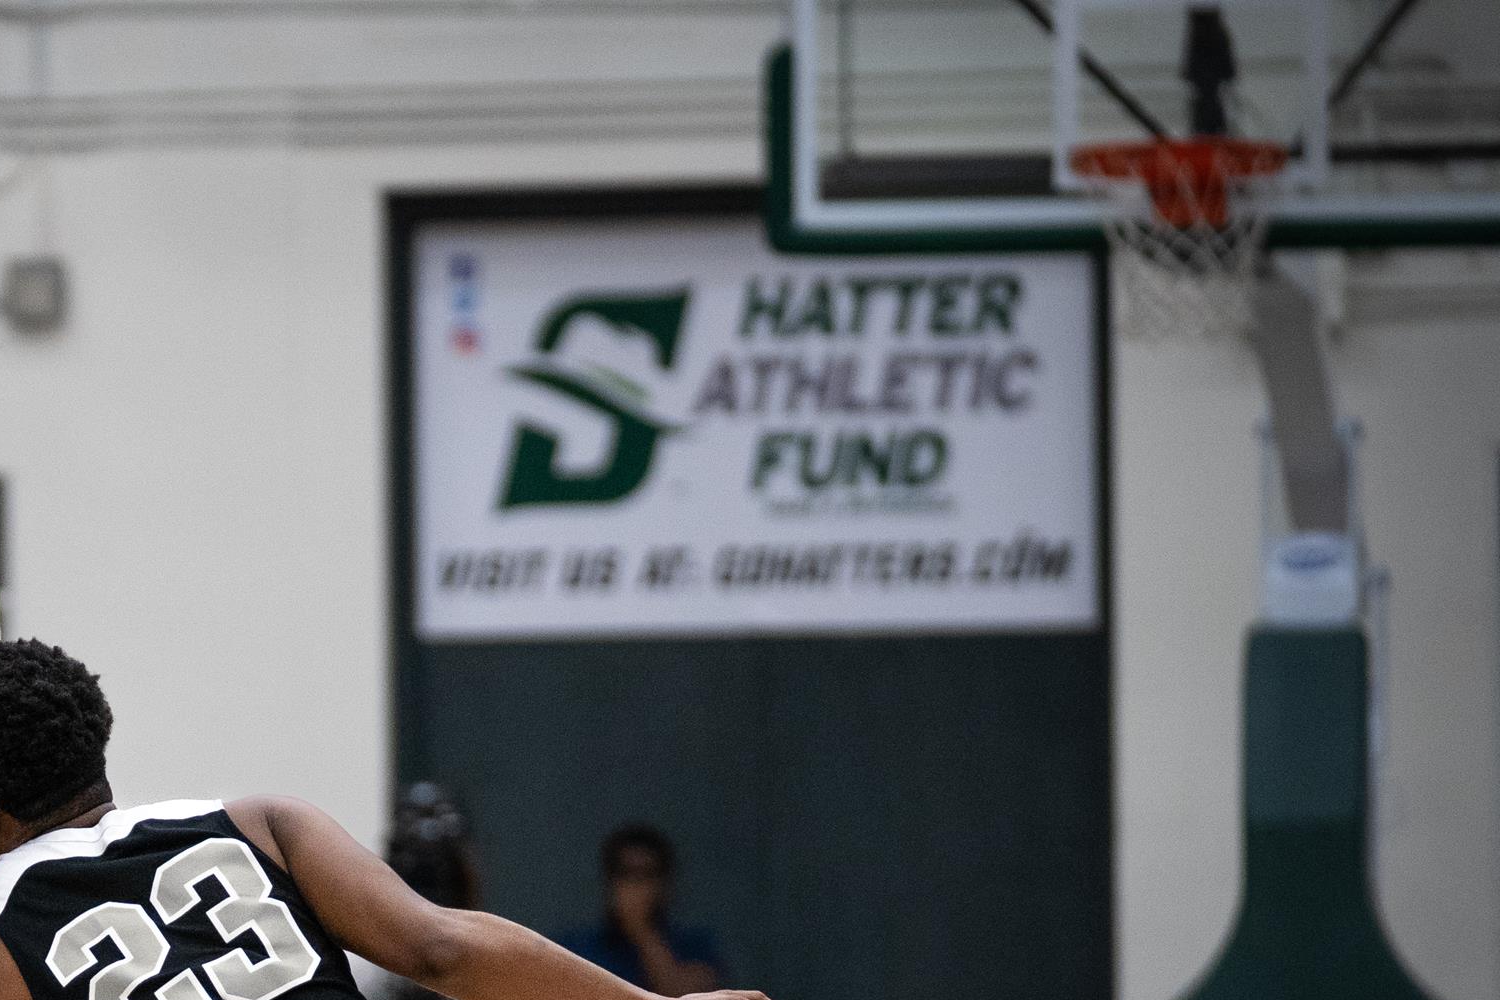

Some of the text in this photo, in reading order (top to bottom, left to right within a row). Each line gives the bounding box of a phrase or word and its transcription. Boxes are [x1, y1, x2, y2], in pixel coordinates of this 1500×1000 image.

[741, 273, 1023, 337] HATTER
[695, 350, 1041, 414] ATHLETIC
[750, 428, 949, 489] FUND
[438, 549, 546, 591] VISIT
[561, 547, 621, 590] US
